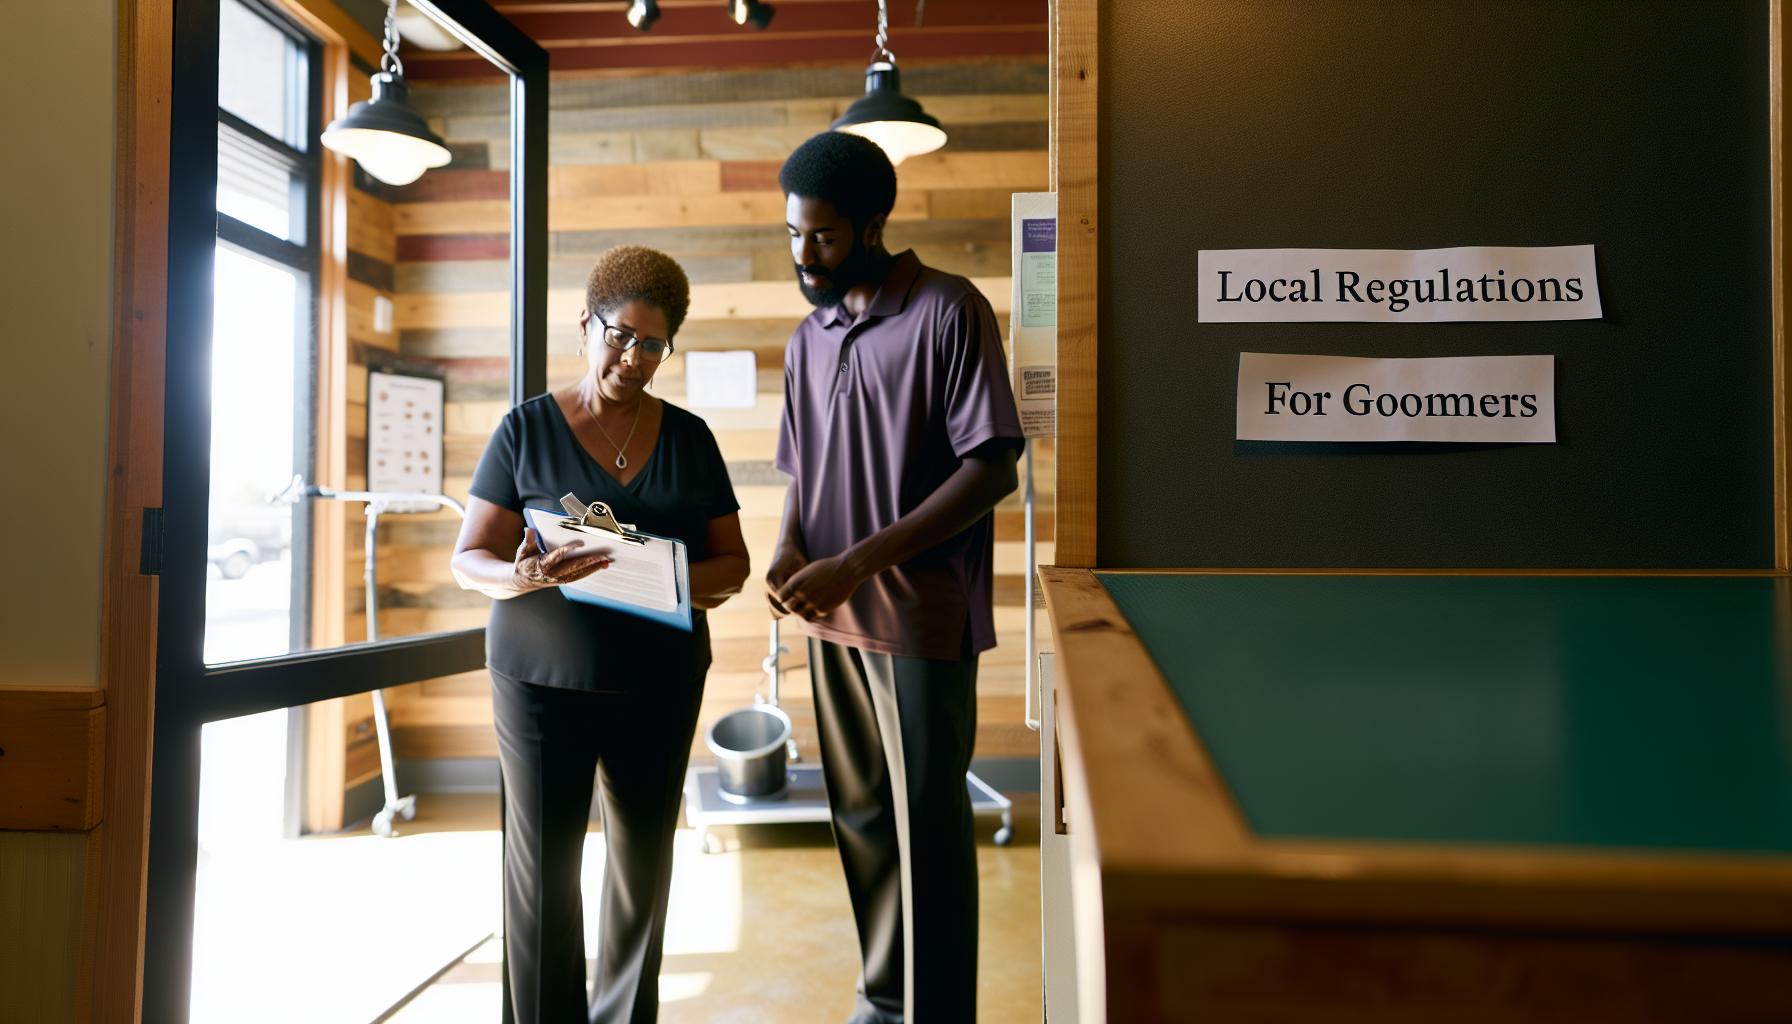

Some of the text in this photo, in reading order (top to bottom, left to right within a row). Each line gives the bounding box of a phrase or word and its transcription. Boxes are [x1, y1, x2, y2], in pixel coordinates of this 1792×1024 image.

[1217, 269, 1583, 313] Local Regulations
[1264, 382, 1332, 416] For
